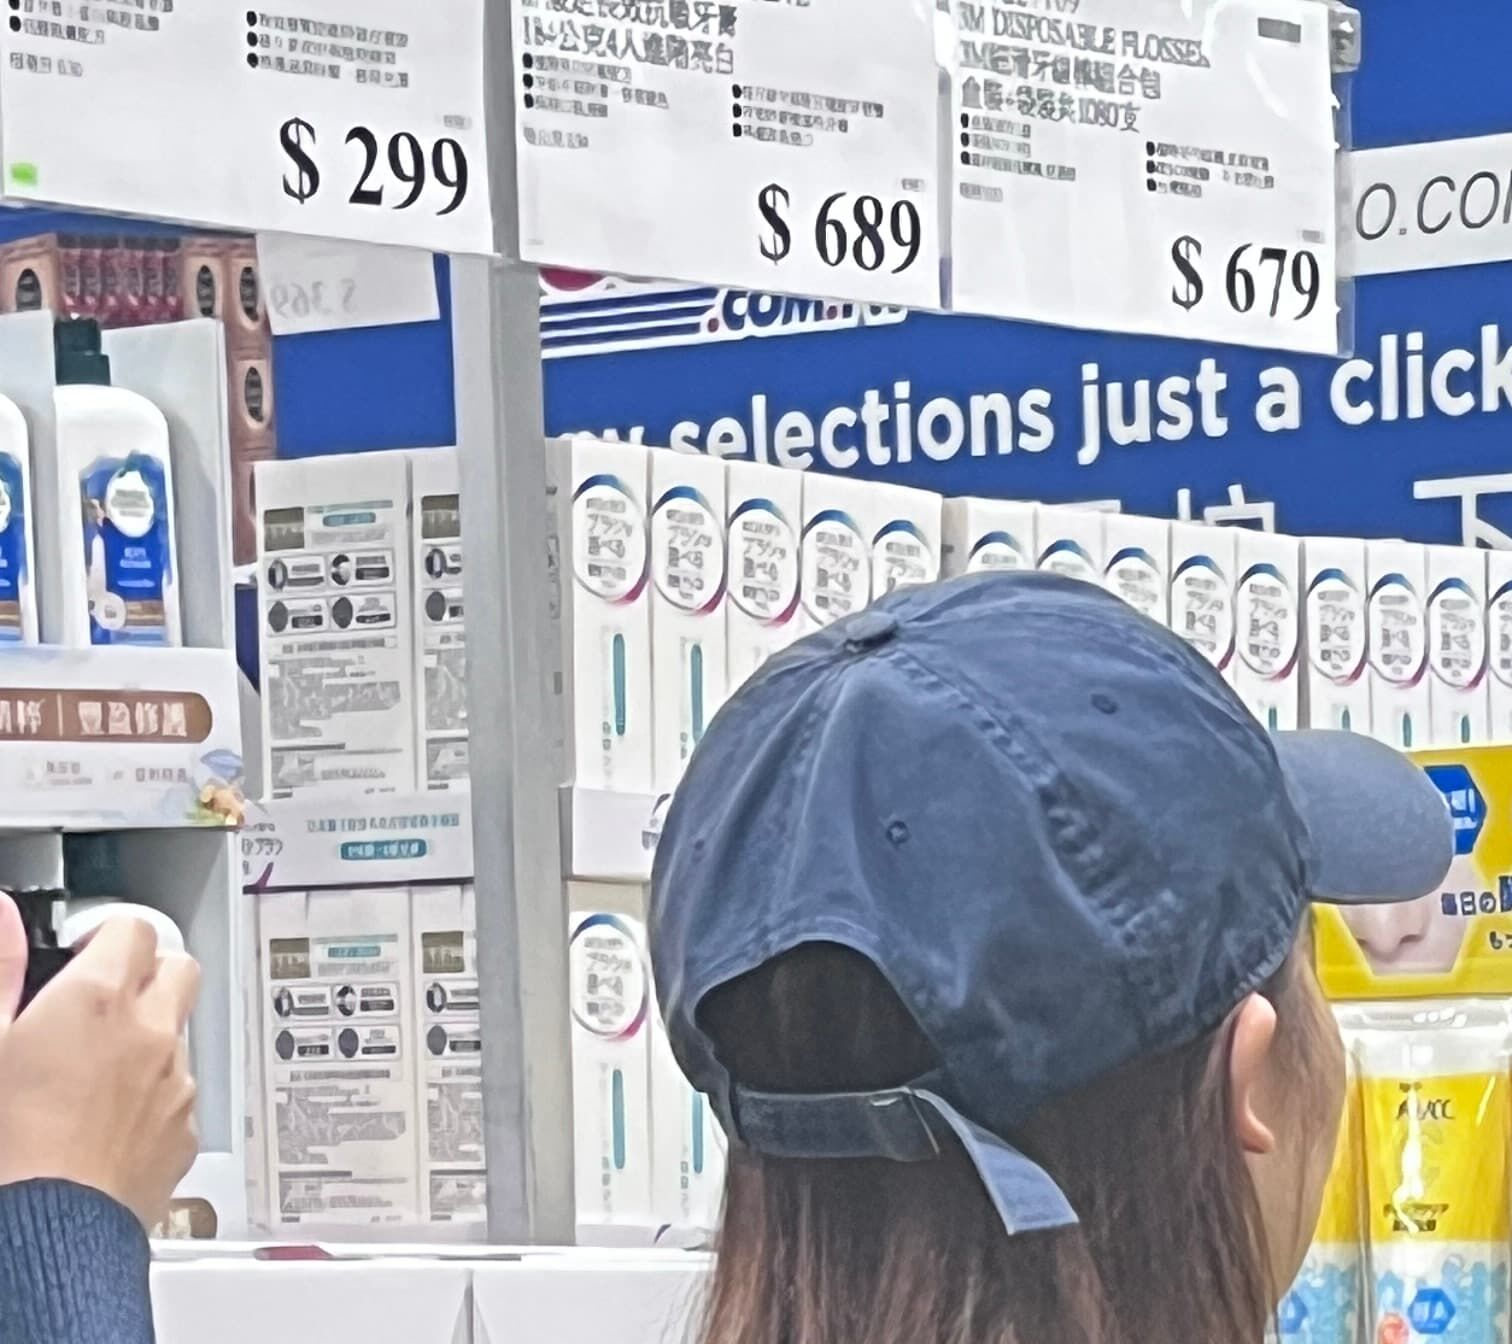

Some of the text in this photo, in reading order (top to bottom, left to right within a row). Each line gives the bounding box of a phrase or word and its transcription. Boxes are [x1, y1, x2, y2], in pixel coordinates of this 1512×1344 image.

[278, 117, 469, 215] $ 299
[757, 184, 922, 275] $ 689
[1170, 236, 1321, 319] $ 679
[670, 380, 1054, 470] selections
[1077, 358, 1229, 466] just
[1254, 364, 1301, 433] a
